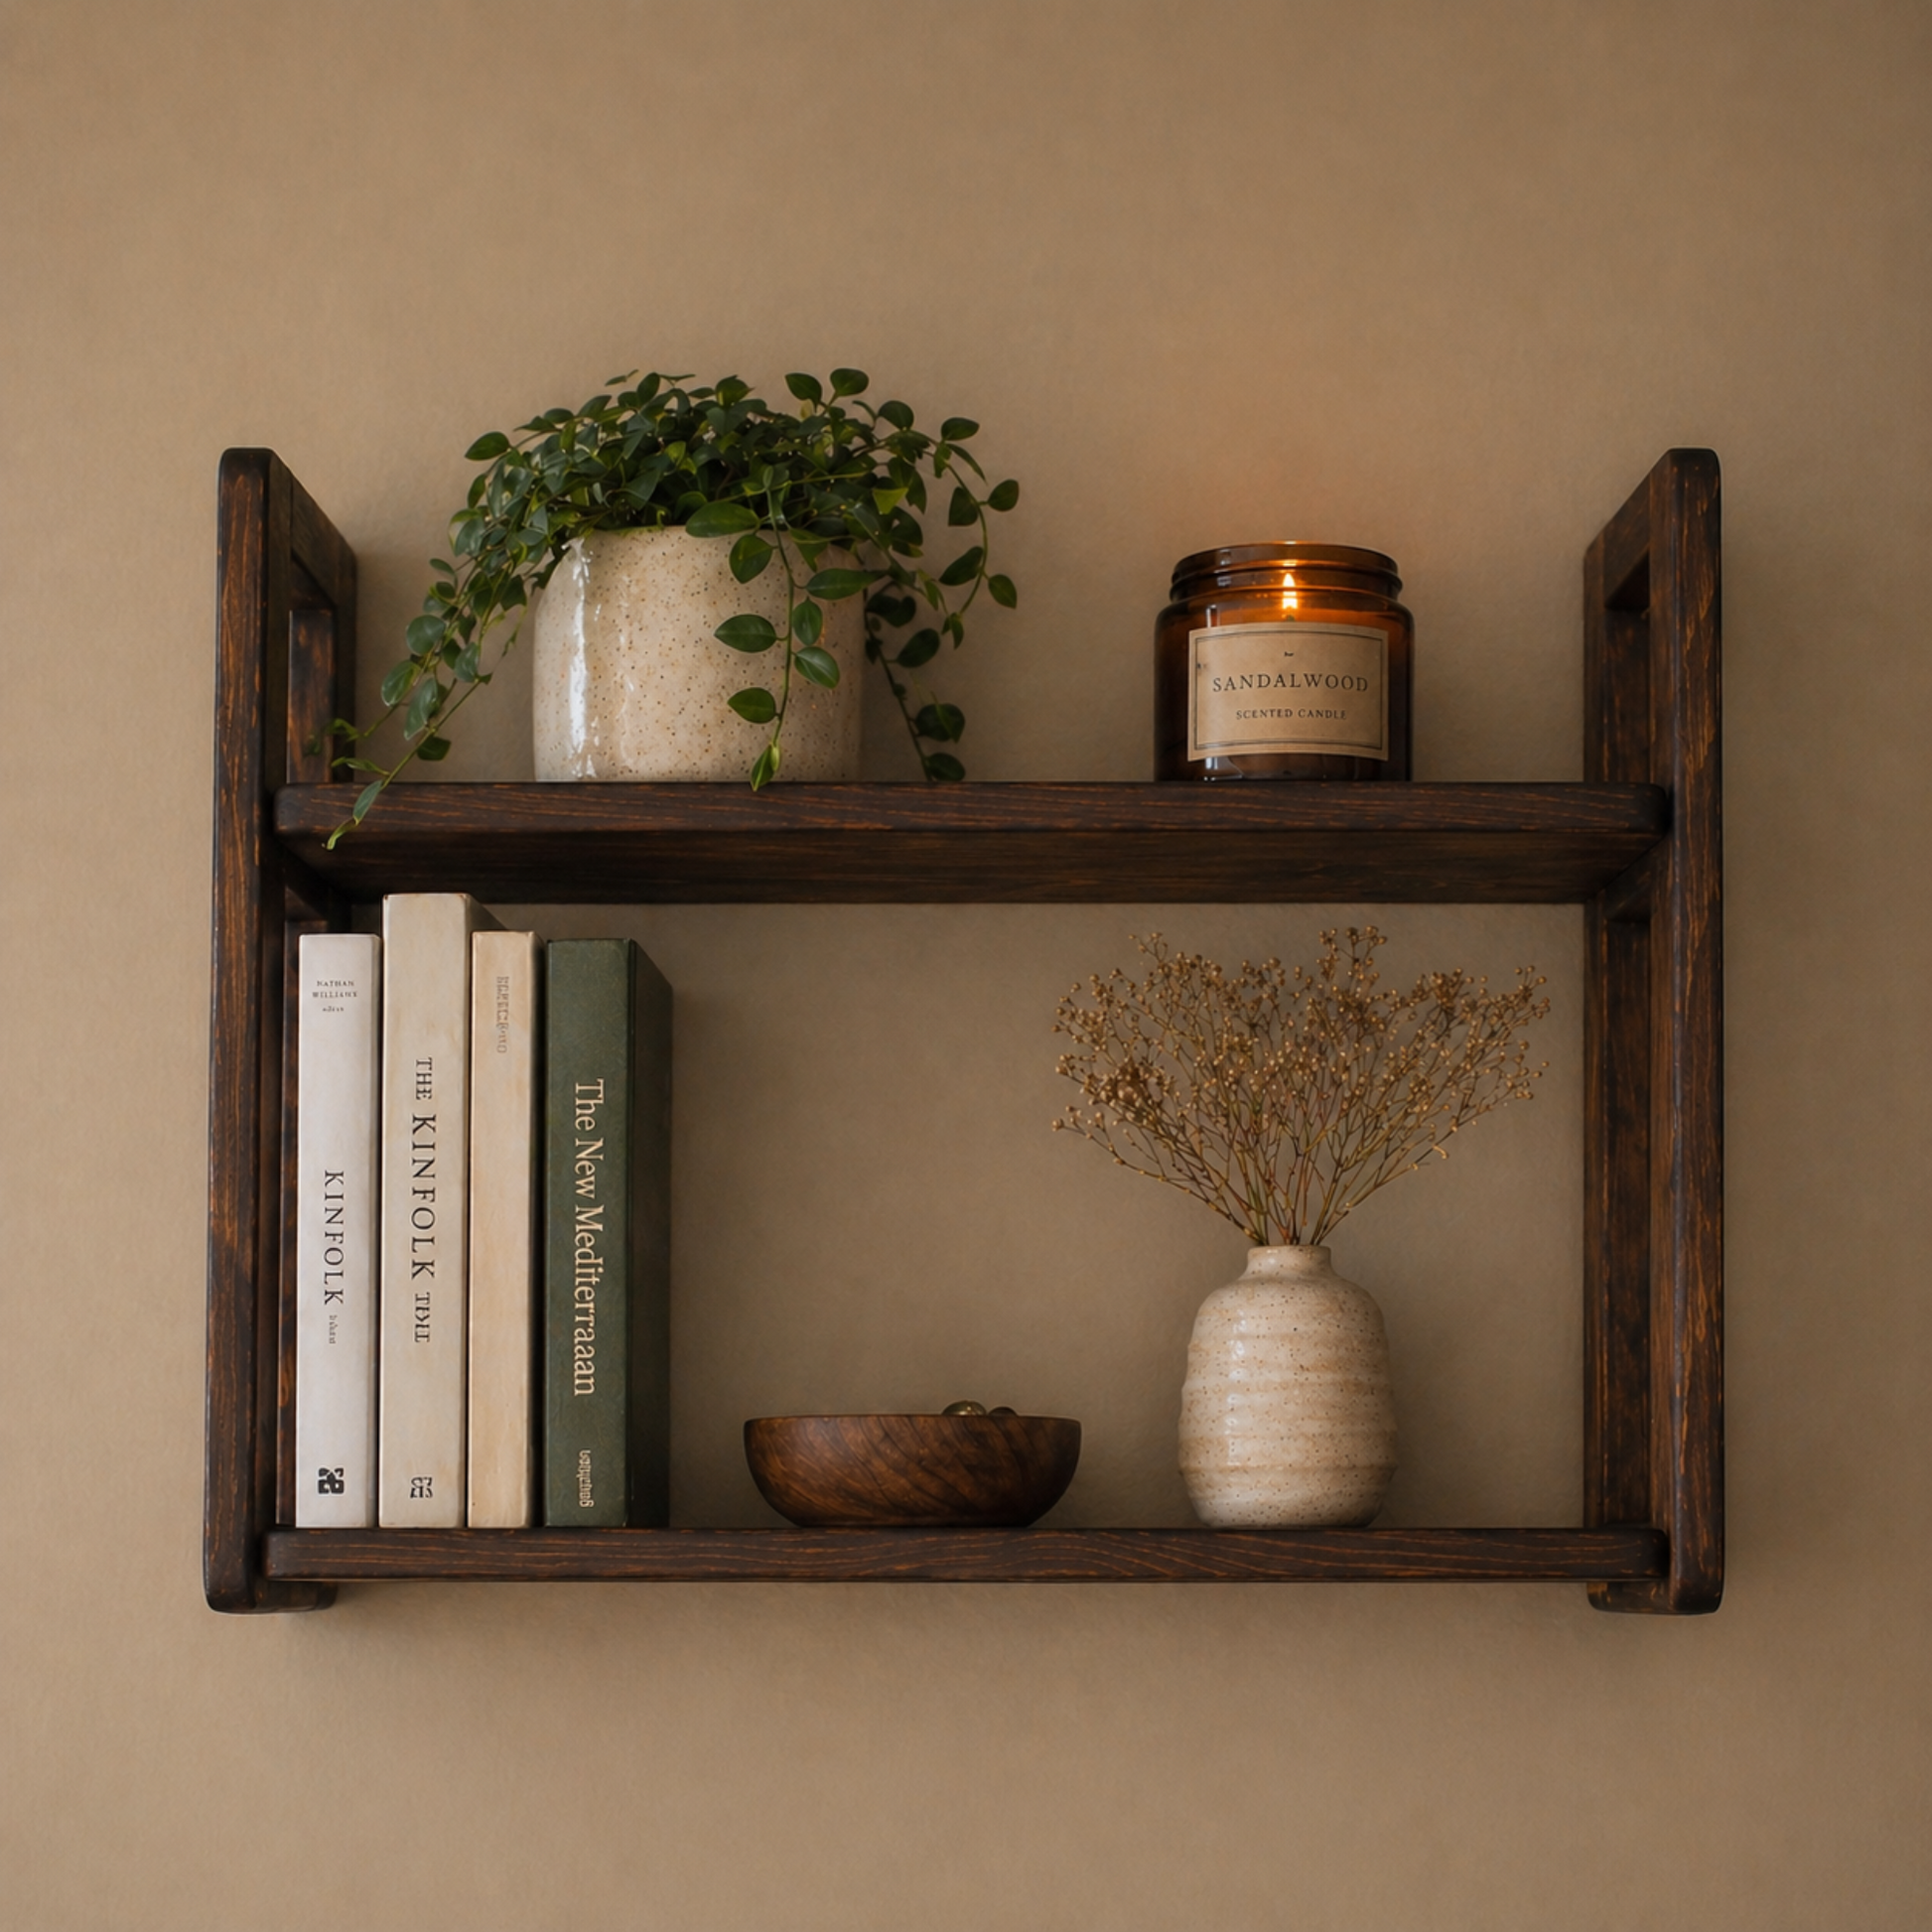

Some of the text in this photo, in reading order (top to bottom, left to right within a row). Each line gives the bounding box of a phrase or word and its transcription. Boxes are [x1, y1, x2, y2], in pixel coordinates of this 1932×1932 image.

[1212, 673, 1369, 692] SANDALWOOD
[1236, 709, 1347, 720] SCENTED CANDLE
[415, 1056, 432, 1100] THE
[324, 1170, 345, 1306] KINFOLK
[411, 1114, 436, 1281] KINFOLK
[574, 1078, 605, 1396] The New Mediterraaan
